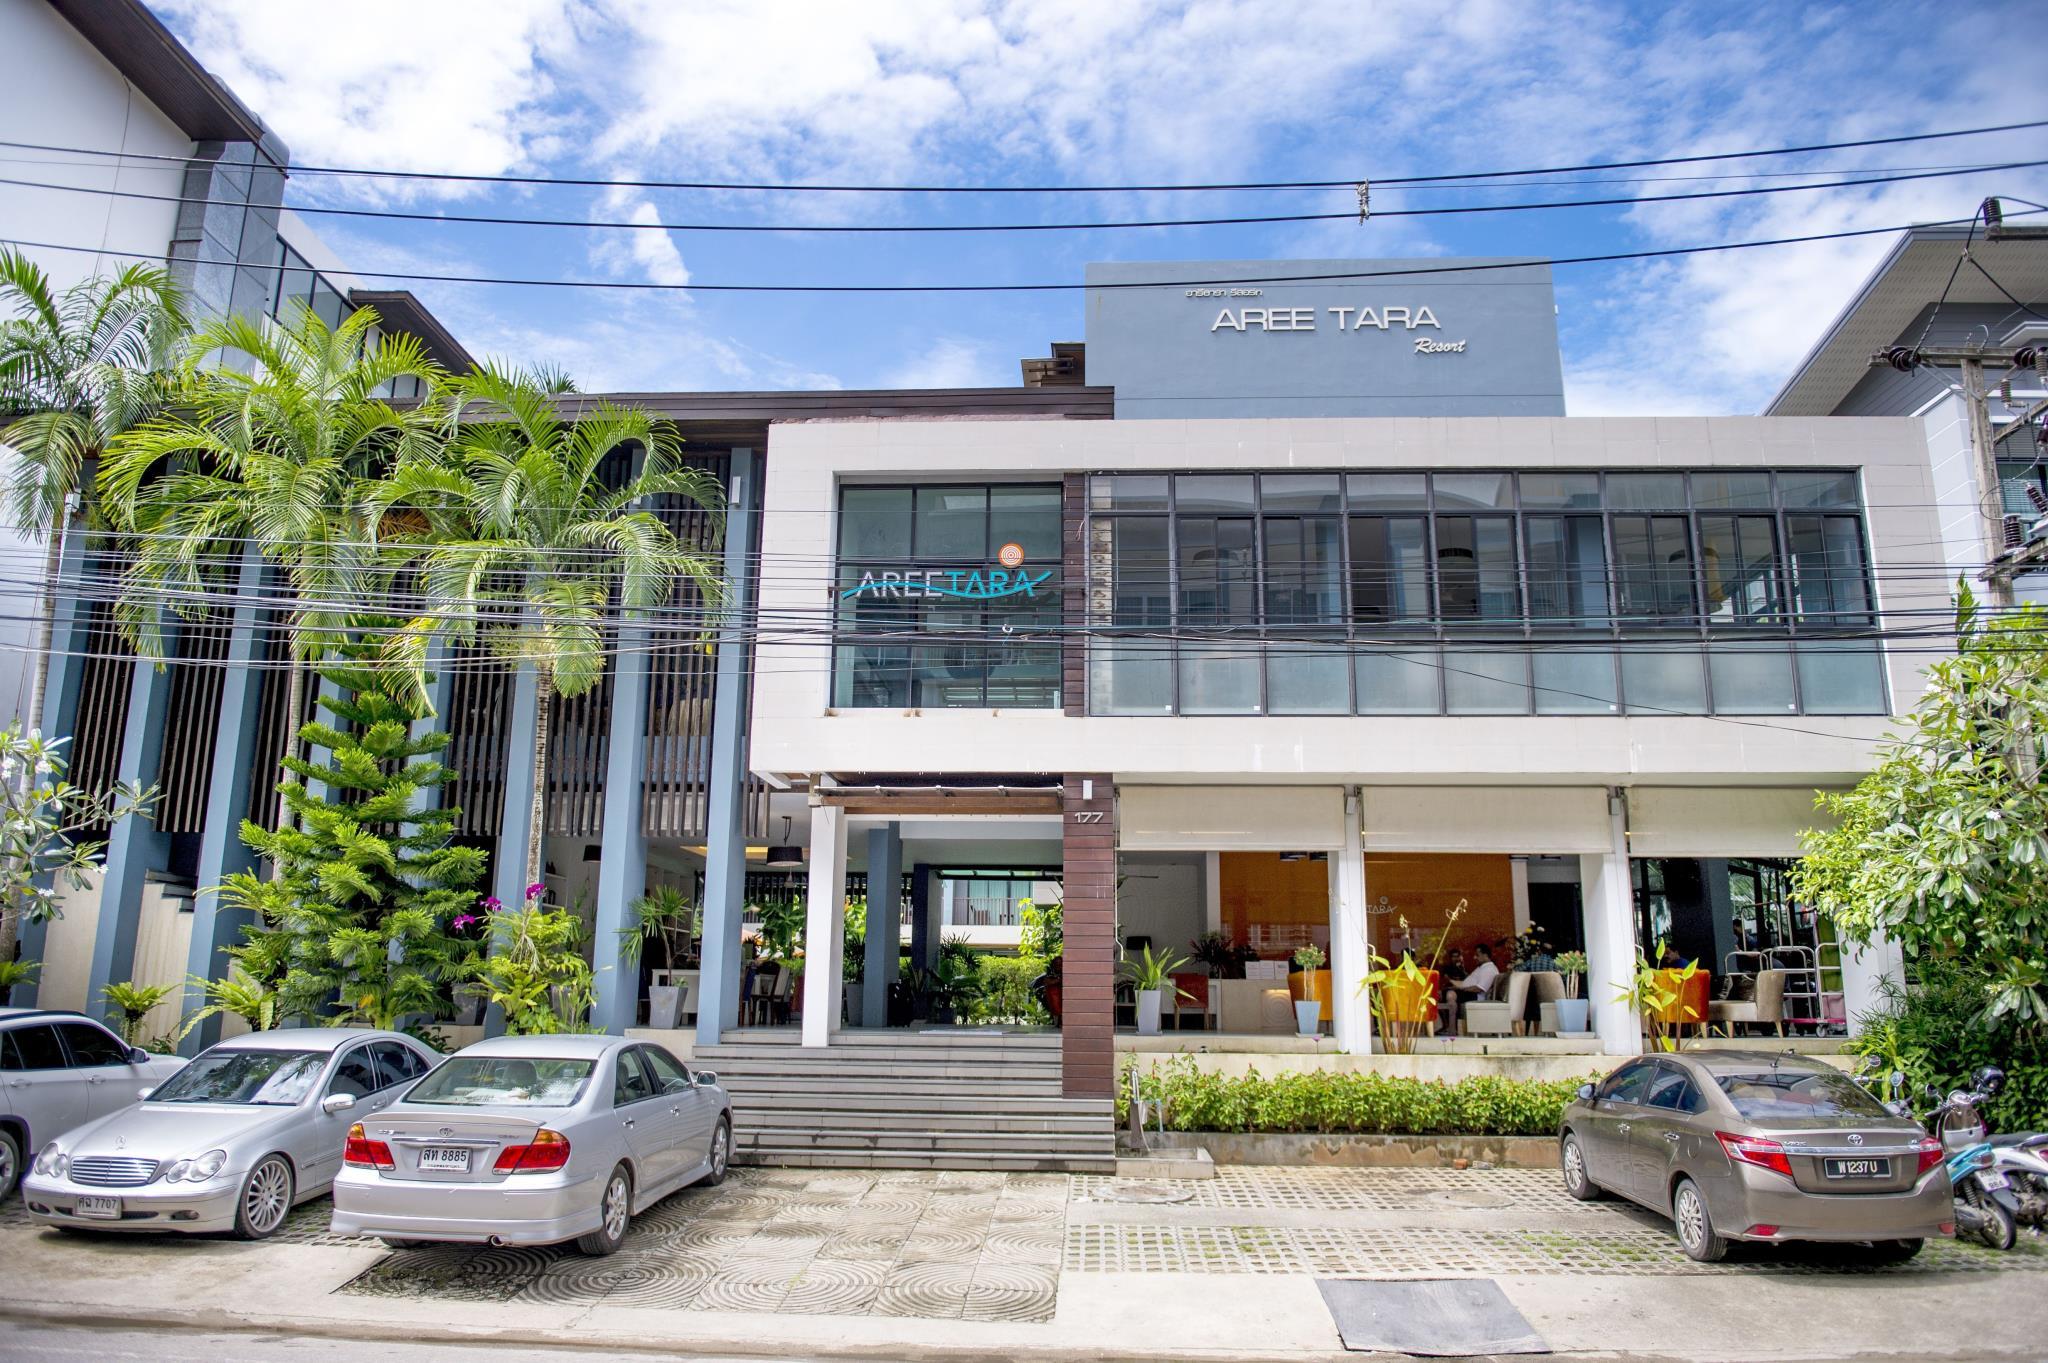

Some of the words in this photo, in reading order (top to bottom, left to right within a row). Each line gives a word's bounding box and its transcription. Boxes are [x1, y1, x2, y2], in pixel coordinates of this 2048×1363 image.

[1211, 307, 1315, 331] AREE
[1328, 305, 1441, 330] TARA
[1414, 337, 1466, 354] Resort
[1074, 811, 1104, 823] 177
[441, 1150, 467, 1161] 8885
[95, 1197, 117, 1209] 7707
